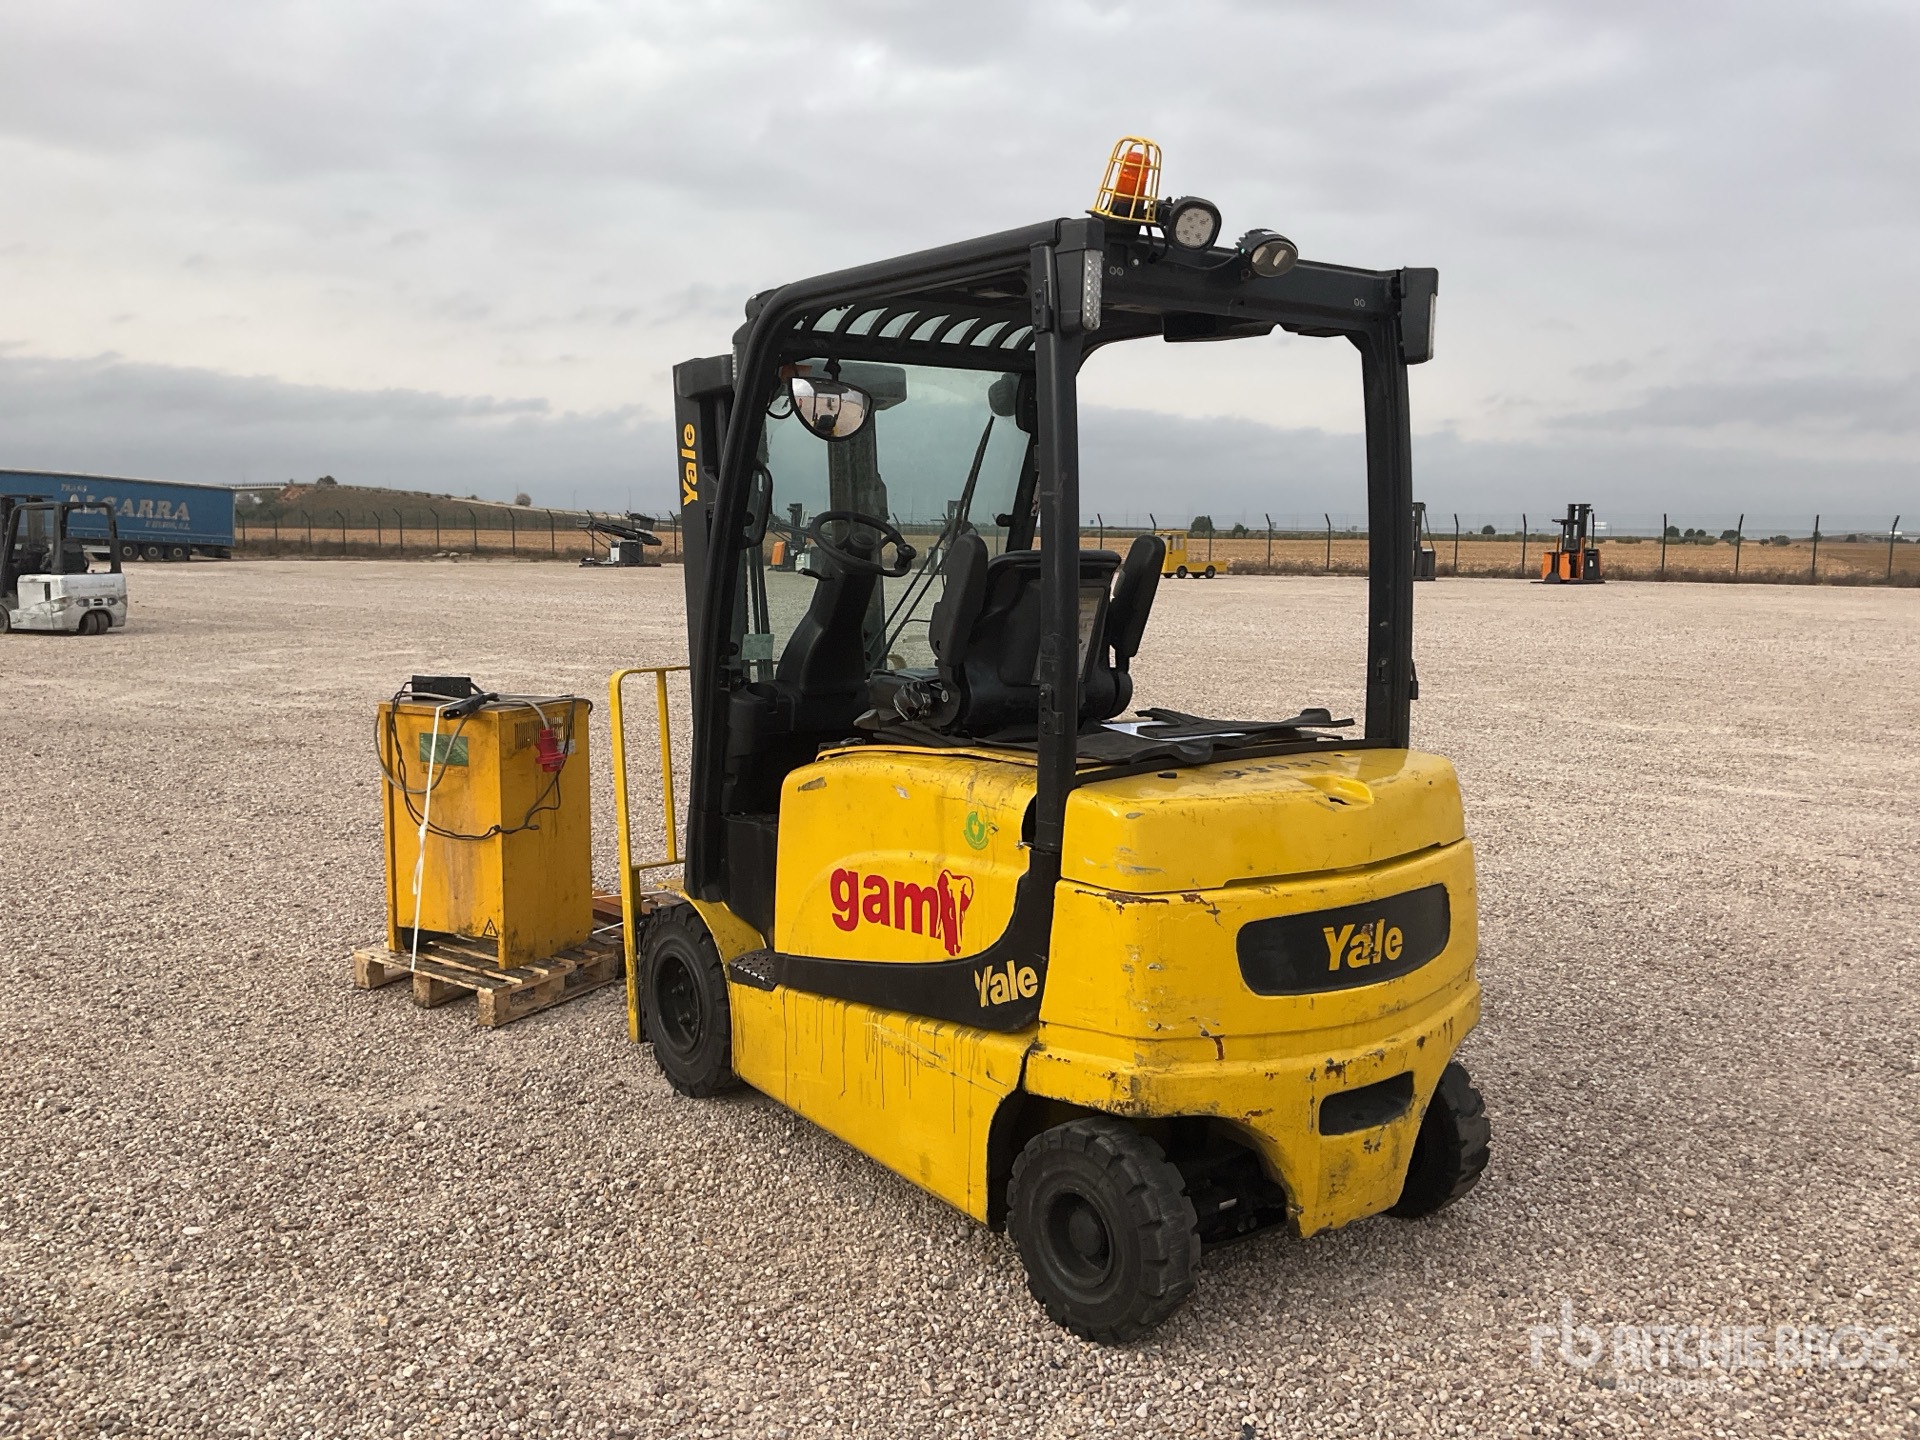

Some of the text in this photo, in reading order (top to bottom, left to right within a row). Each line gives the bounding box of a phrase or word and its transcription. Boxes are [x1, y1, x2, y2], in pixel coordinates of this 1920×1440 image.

[681, 423, 699, 507] Yale
[830, 867, 942, 940] gam
[1323, 918, 1403, 971] Yale
[974, 960, 1038, 1008] Yale
